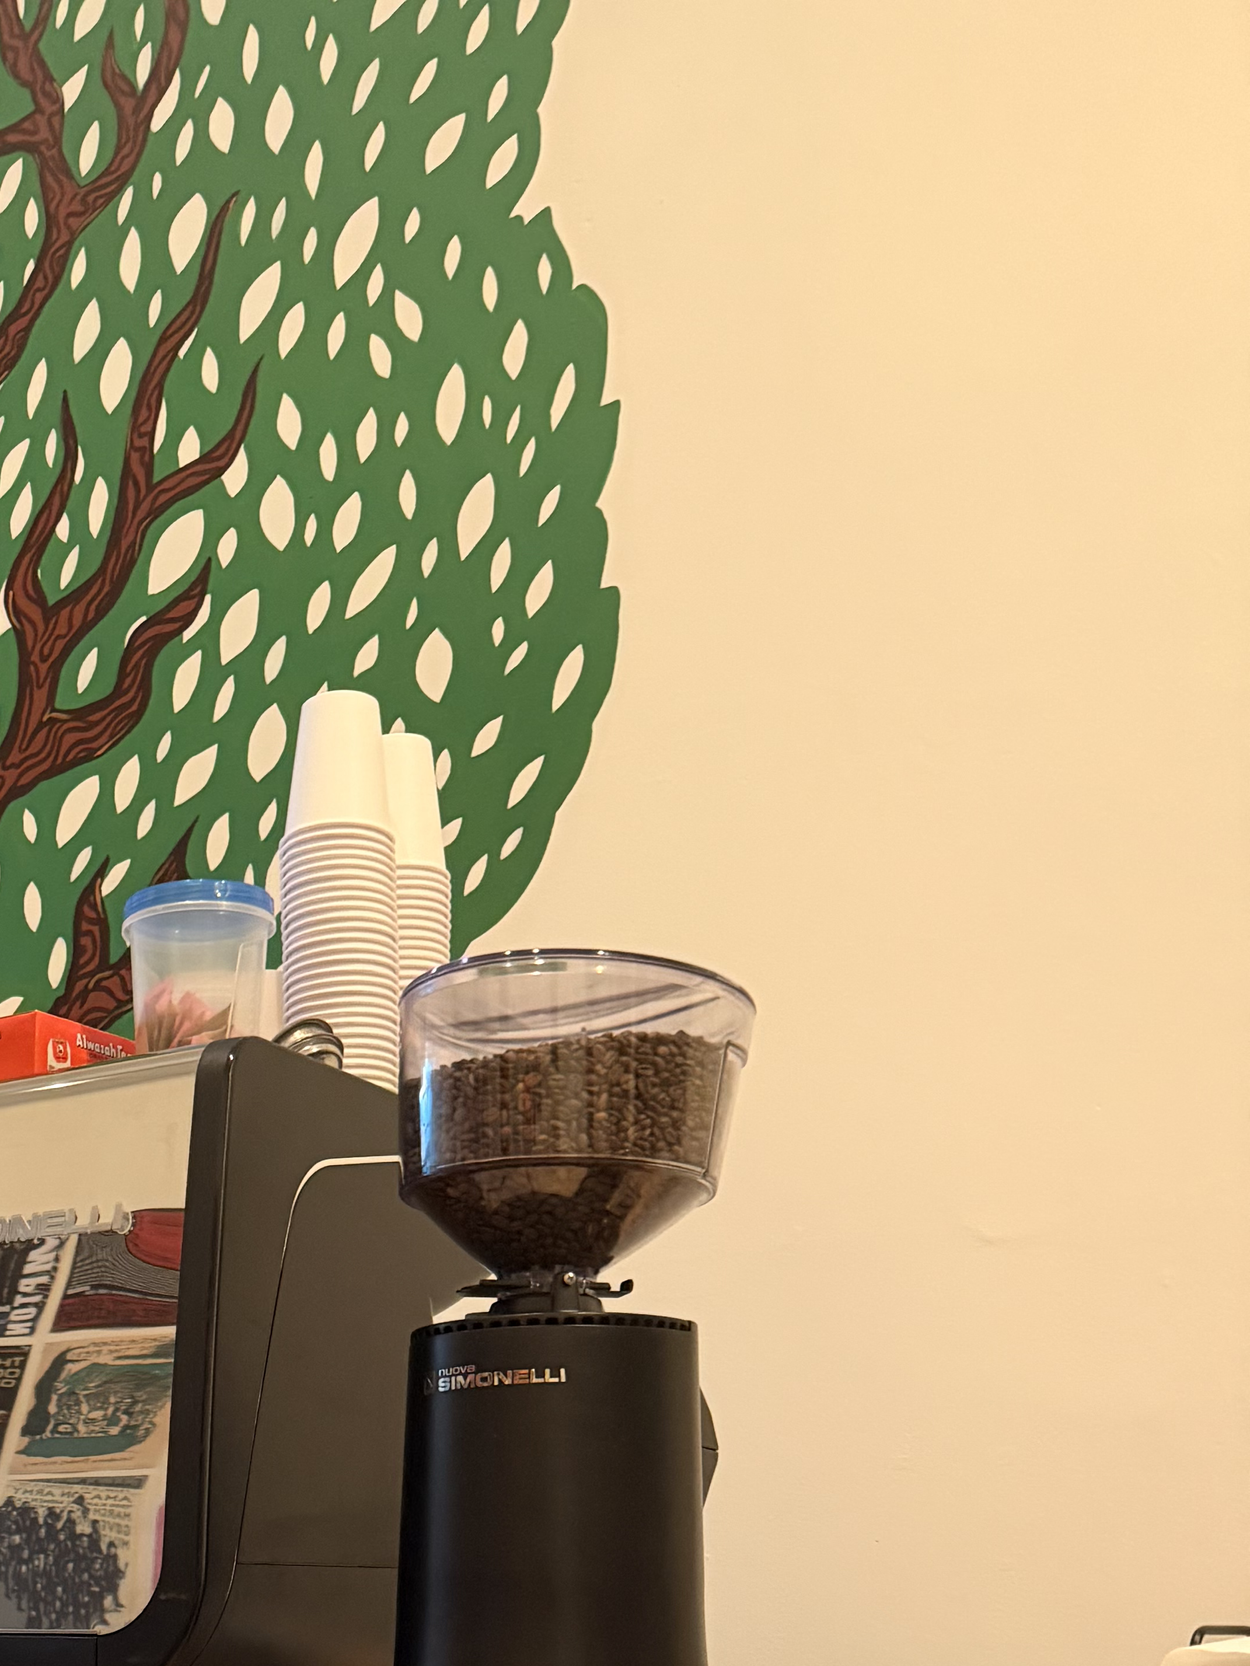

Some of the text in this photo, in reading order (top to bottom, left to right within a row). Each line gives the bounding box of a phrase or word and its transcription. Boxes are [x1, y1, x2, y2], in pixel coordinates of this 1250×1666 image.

[116, 1044, 132, 1059] Te
[438, 1364, 476, 1377] nuova
[438, 1367, 567, 1393] SIMONELLI
